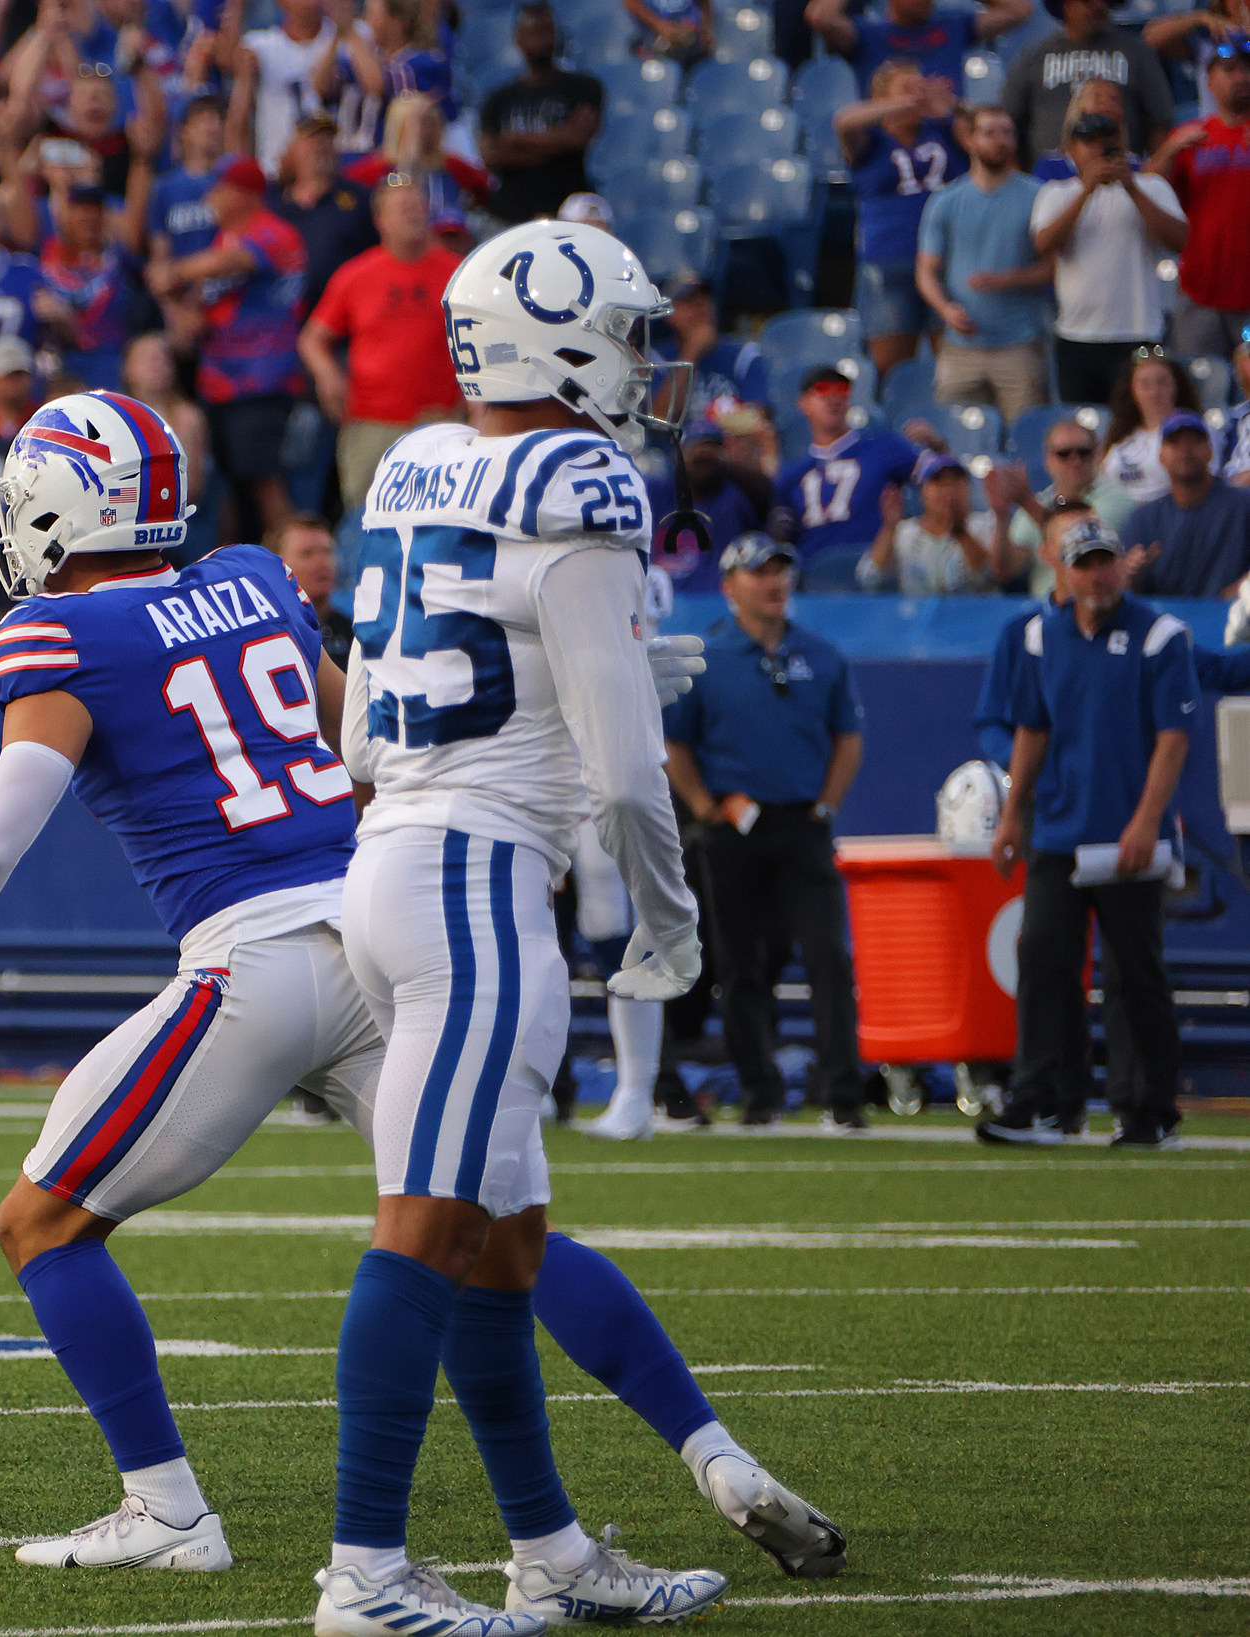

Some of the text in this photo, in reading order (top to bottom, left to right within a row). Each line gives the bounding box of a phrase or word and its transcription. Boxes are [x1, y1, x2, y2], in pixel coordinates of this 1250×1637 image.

[890, 141, 948, 196] 12
[376, 457, 492, 512] THOMAS II
[571, 474, 643, 532] 25
[801, 458, 861, 529] 17
[101, 514, 116, 525] NFL
[134, 526, 183, 545] BILLS
[146, 577, 279, 649] ARAIZA
[353, 525, 516, 749] 25
[161, 632, 353, 834] 19
